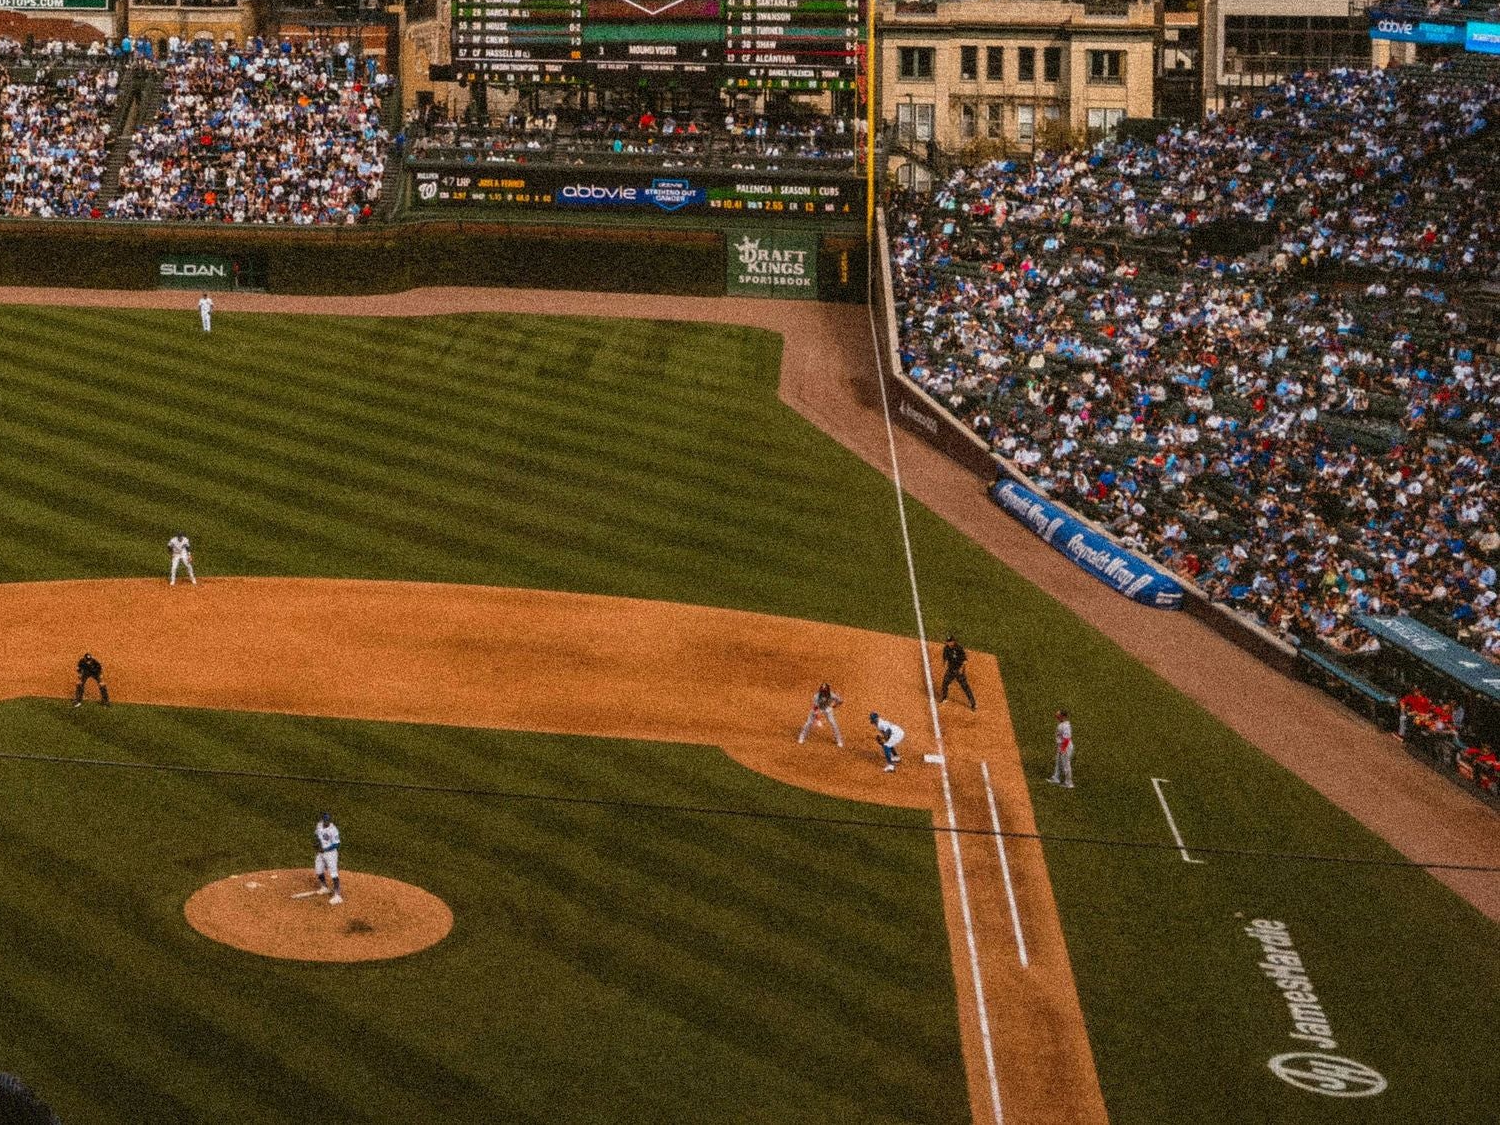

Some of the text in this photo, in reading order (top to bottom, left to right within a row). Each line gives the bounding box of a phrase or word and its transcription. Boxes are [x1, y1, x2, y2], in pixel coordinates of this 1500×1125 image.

[755, 12, 791, 21] SWANSON
[1377, 19, 1413, 36] abbvie
[656, 46, 677, 56] VISITS
[755, 40, 777, 49] SHAW
[562, 183, 637, 200] abbvie
[736, 184, 840, 196] PALENCIA SEASON CUBS
[739, 248, 807, 264] DRAFT
[746, 262, 805, 276] KINGS
[739, 275, 811, 287] SPORTSBOOK
[1067, 533, 1111, 569] Reynolds
[1104, 557, 1136, 590] Wrap
